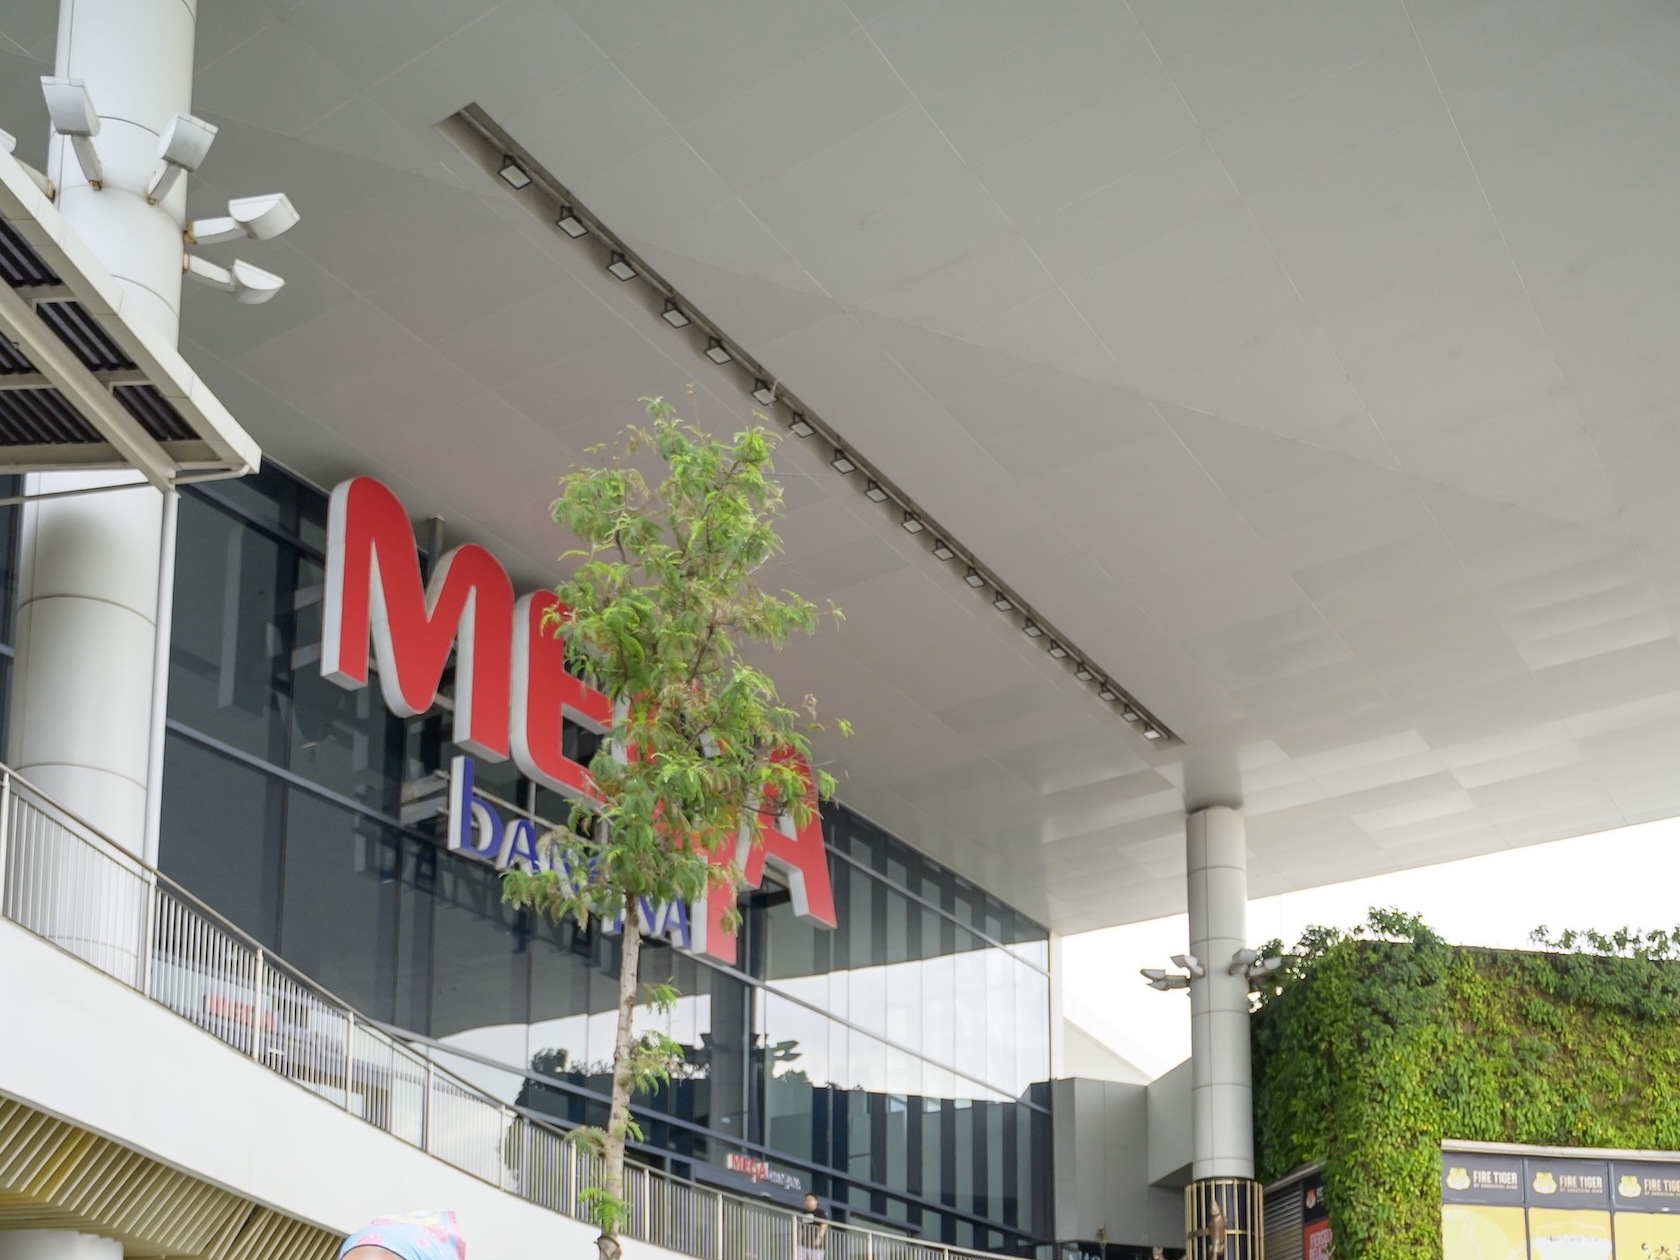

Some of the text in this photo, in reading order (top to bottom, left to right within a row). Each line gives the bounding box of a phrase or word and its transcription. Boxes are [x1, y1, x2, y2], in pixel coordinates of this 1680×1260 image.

[1473, 1170, 1517, 1184] FIRE TIGER
[1560, 1175, 1602, 1188] FIRE TIGER
[1644, 1178, 1661, 1191] FIRE
